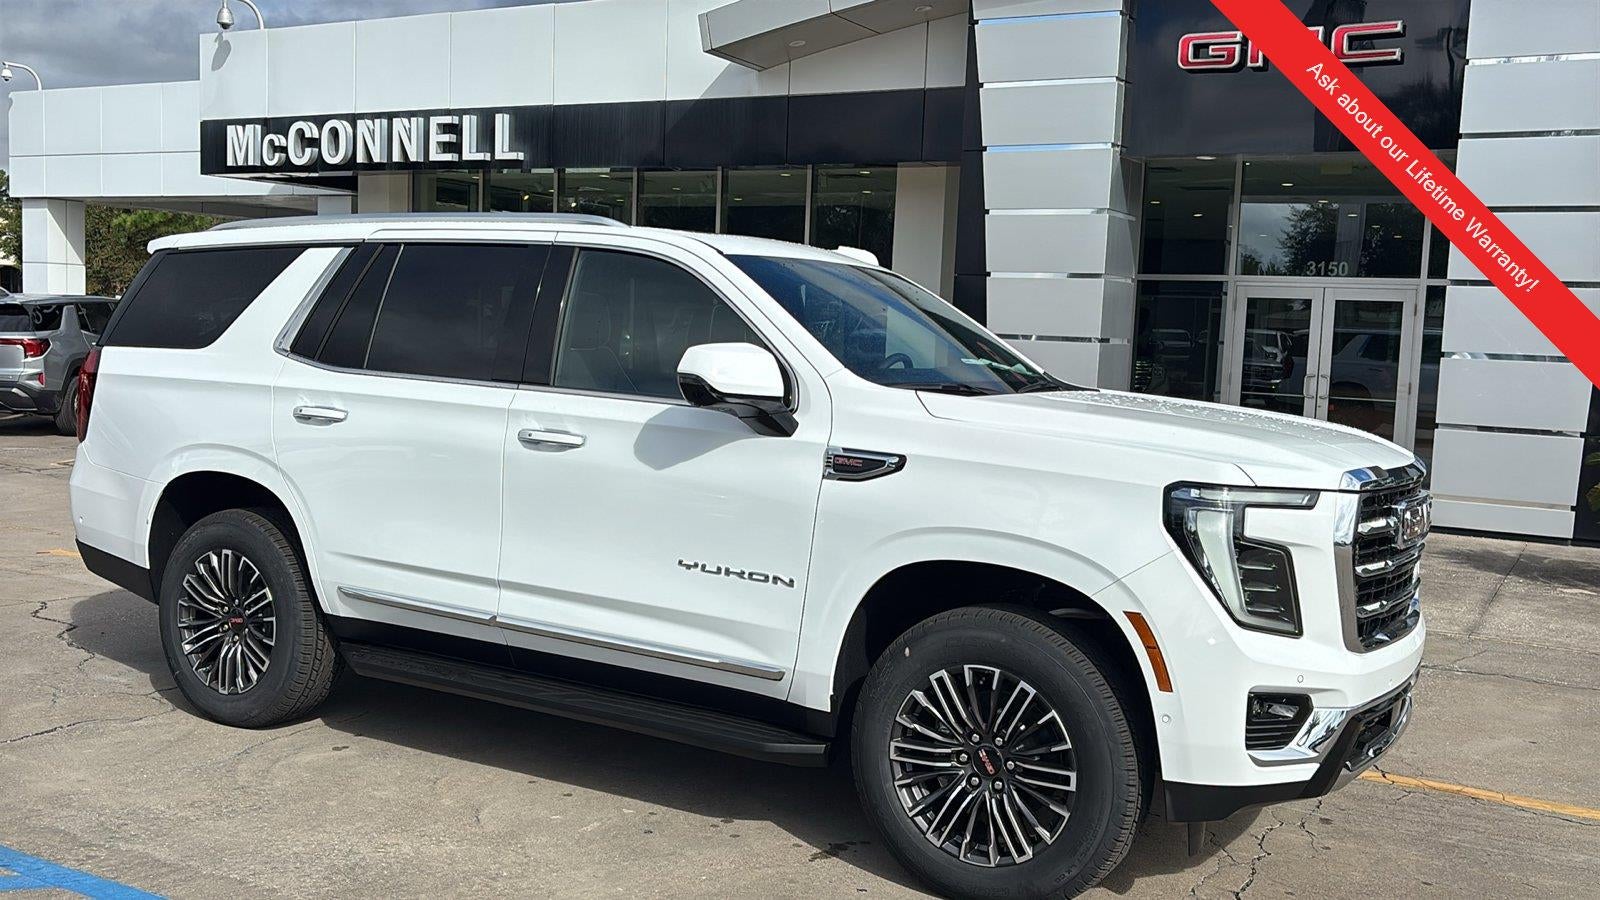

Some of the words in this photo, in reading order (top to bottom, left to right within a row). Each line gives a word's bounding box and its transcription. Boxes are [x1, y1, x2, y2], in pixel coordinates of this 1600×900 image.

[1178, 20, 1403, 70] GC
[226, 113, 525, 167] McCONNELL
[1306, 260, 1349, 276] 3150
[834, 456, 863, 467] GMC
[677, 558, 795, 588] YUKON
